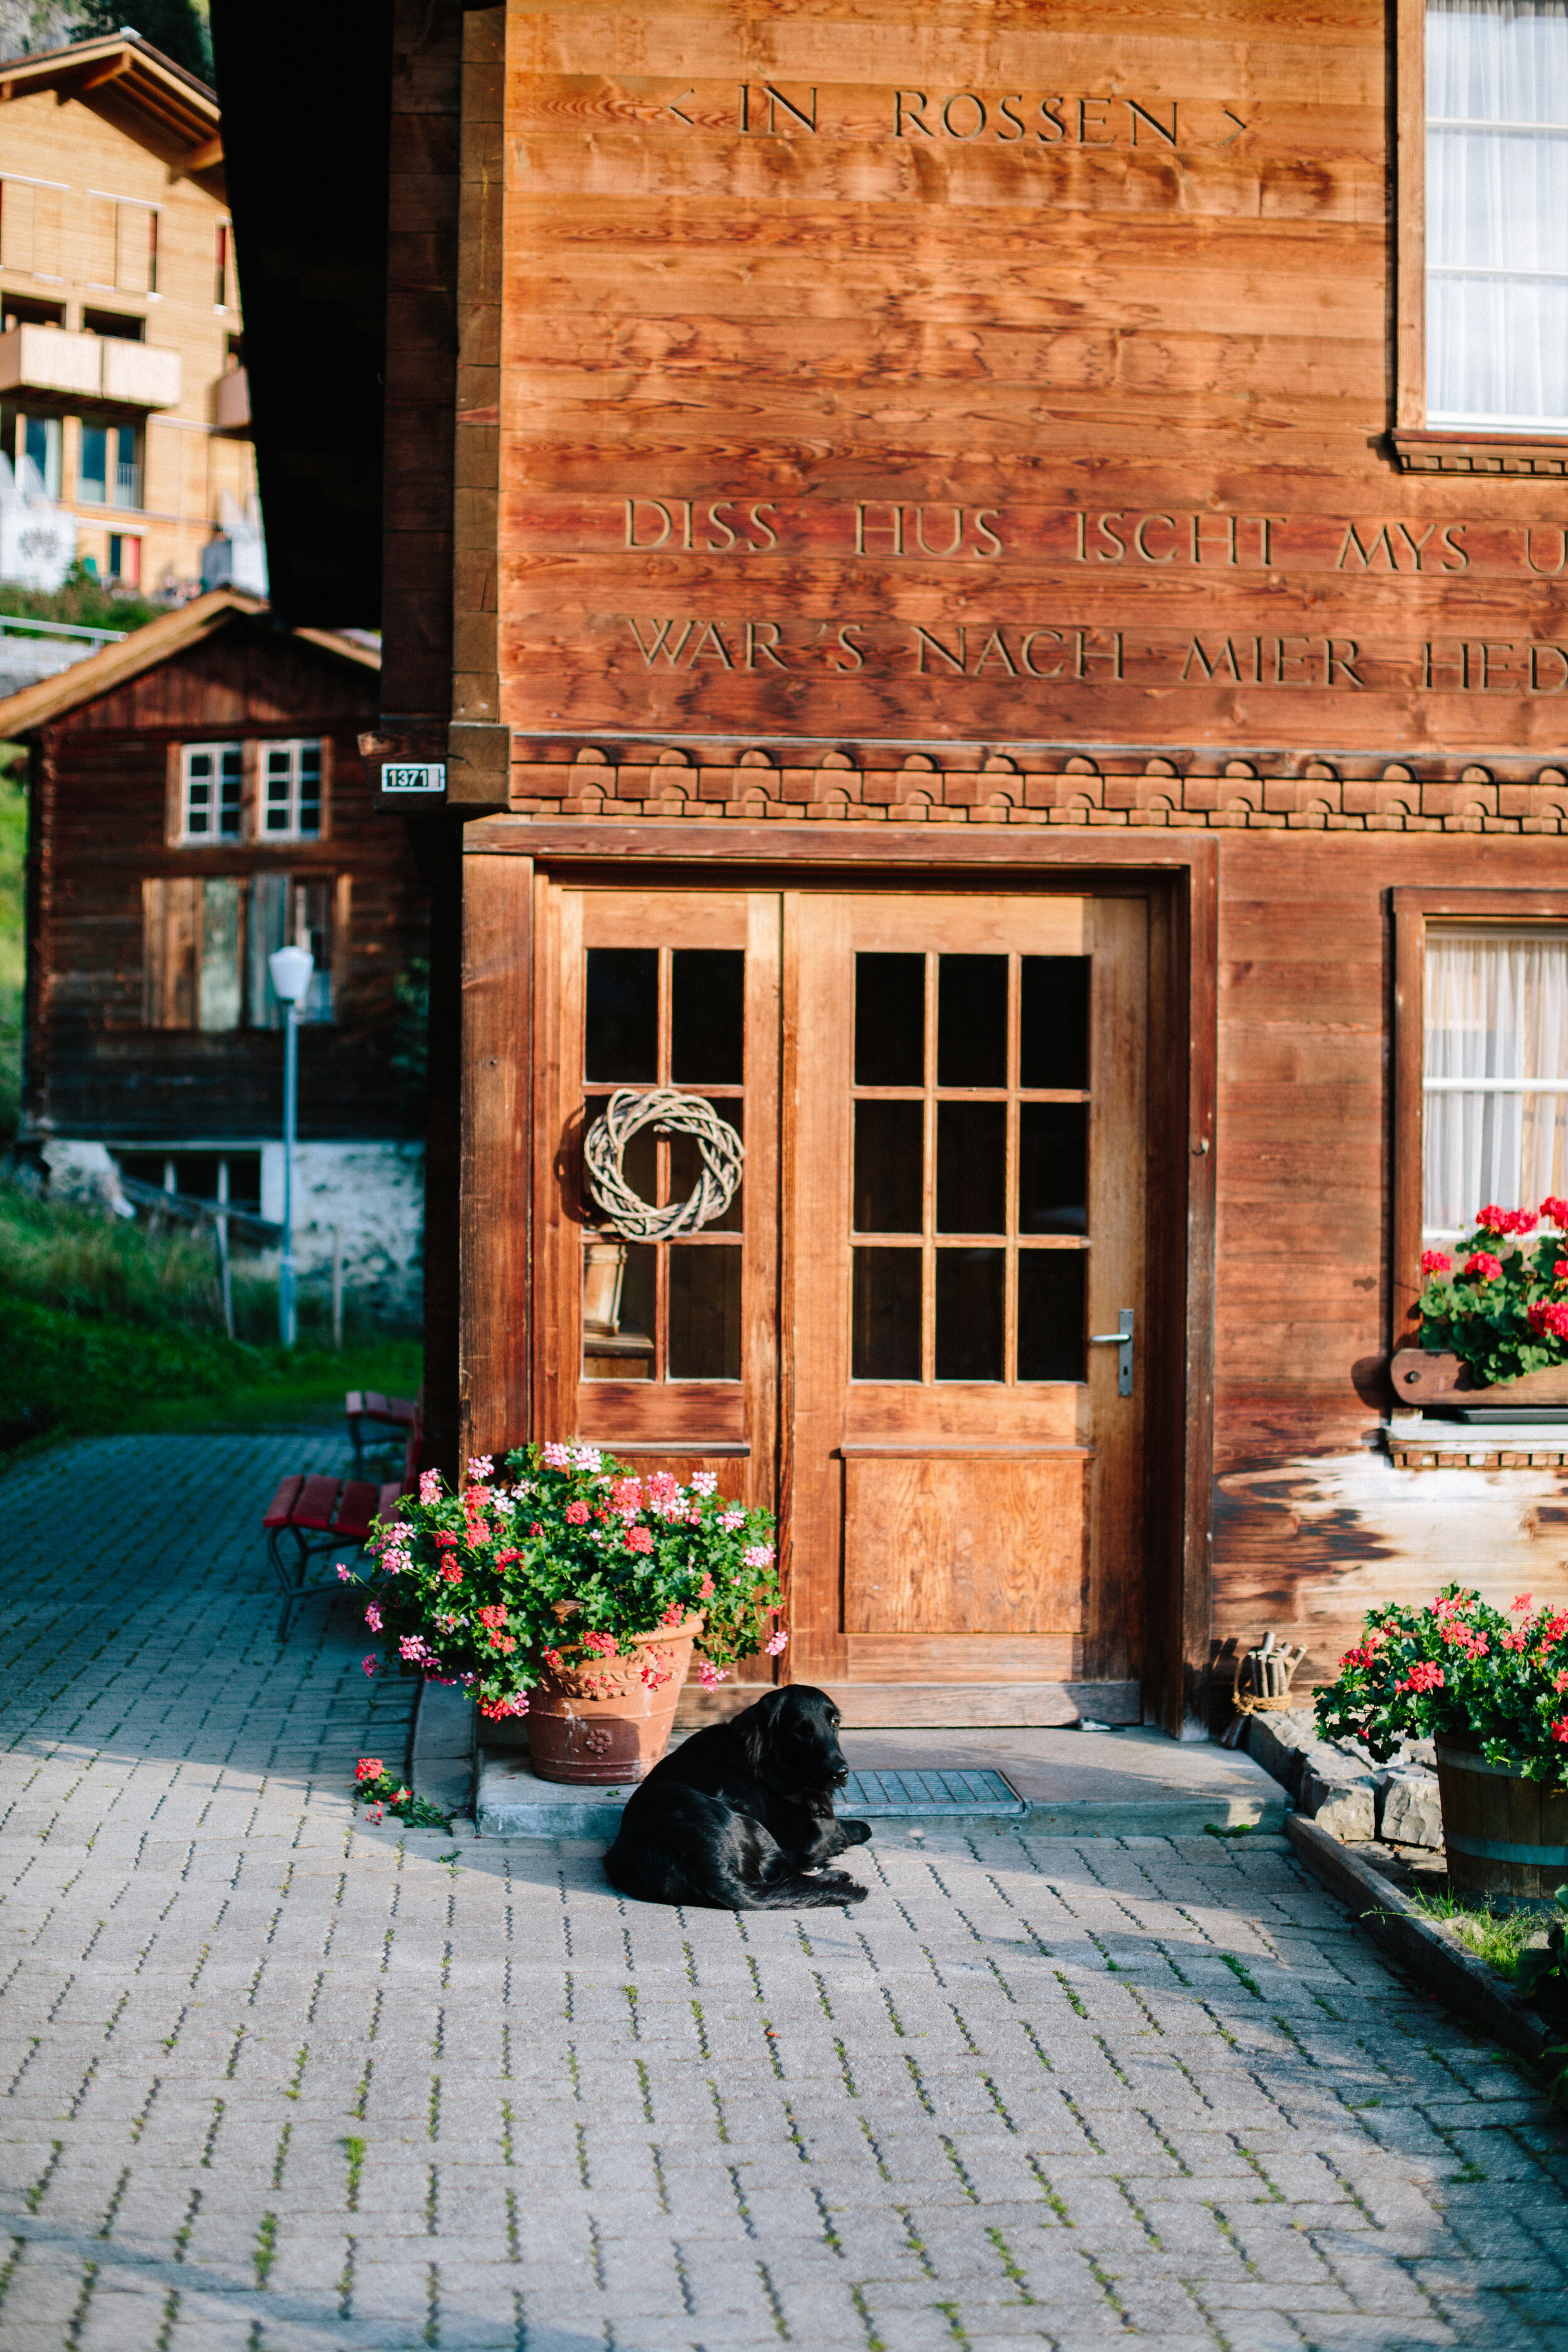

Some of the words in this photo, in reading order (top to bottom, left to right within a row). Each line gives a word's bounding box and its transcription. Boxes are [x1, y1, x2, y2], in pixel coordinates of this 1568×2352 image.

[738, 84, 818, 135] IN
[892, 90, 1178, 147] ROSSEN
[625, 499, 780, 552] DISS
[854, 504, 1004, 558] HUS
[1074, 511, 1288, 567] ISCHT
[1335, 522, 1470, 573] MYS
[911, 627, 1125, 681] NACH
[1179, 634, 1365, 687] MIER
[1421, 641, 1568, 694] HED
[389, 770, 428, 787] 1371
